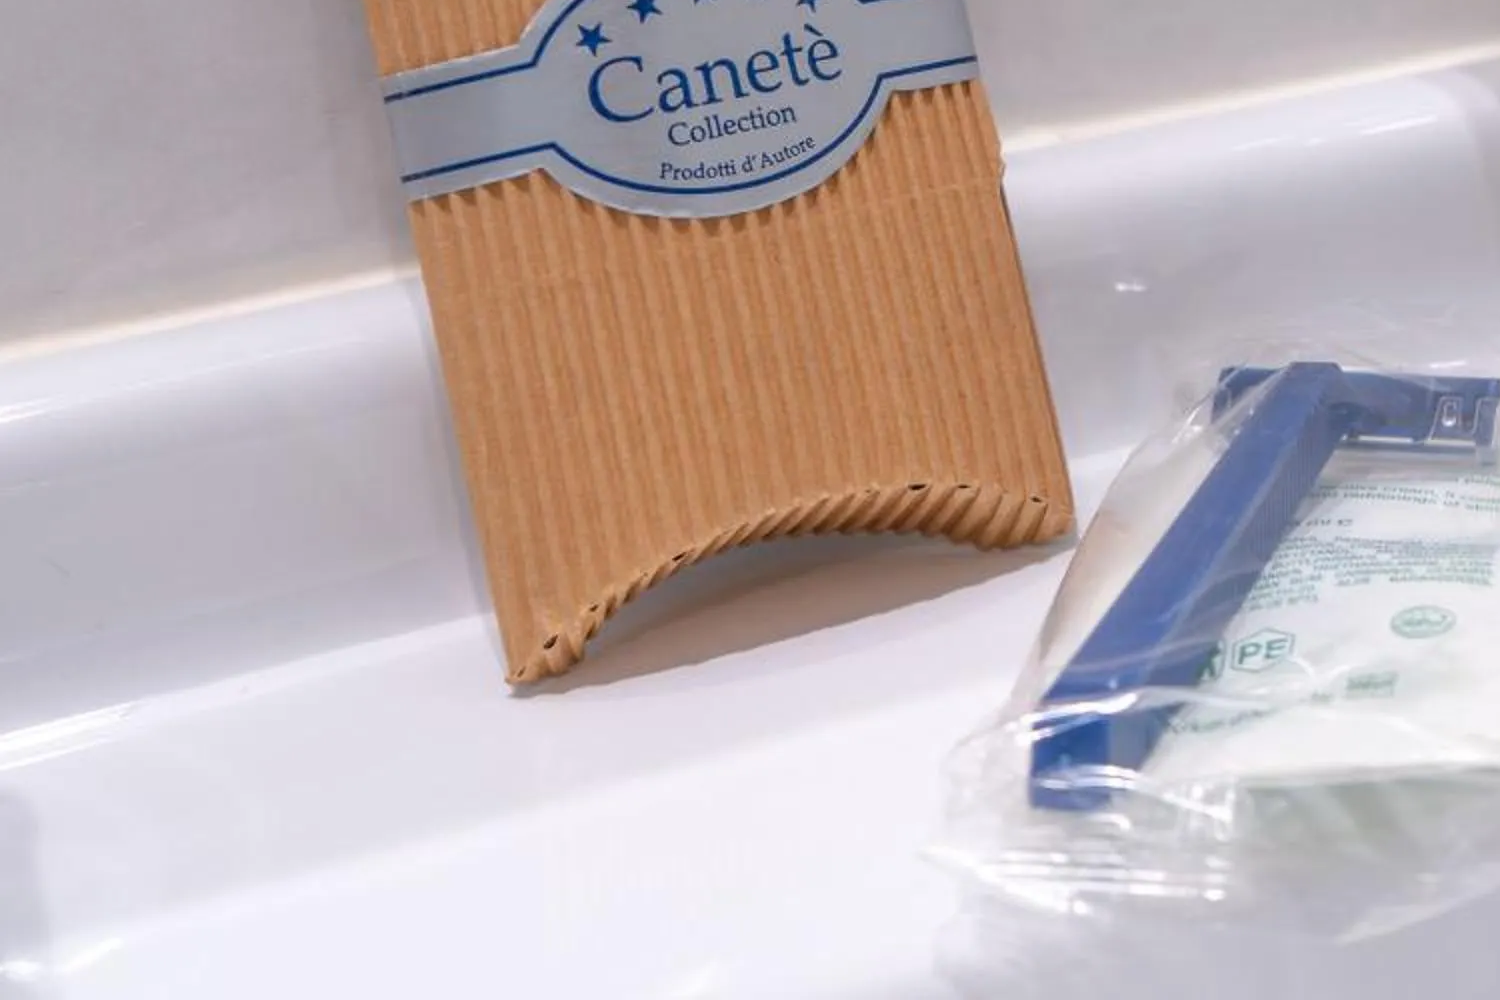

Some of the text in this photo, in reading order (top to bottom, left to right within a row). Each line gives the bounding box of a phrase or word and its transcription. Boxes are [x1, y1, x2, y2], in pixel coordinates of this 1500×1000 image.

[588, 24, 842, 123] Canetè
[667, 106, 796, 147] Collection
[659, 160, 737, 180] Prodotti
[1238, 638, 1289, 666] PE
